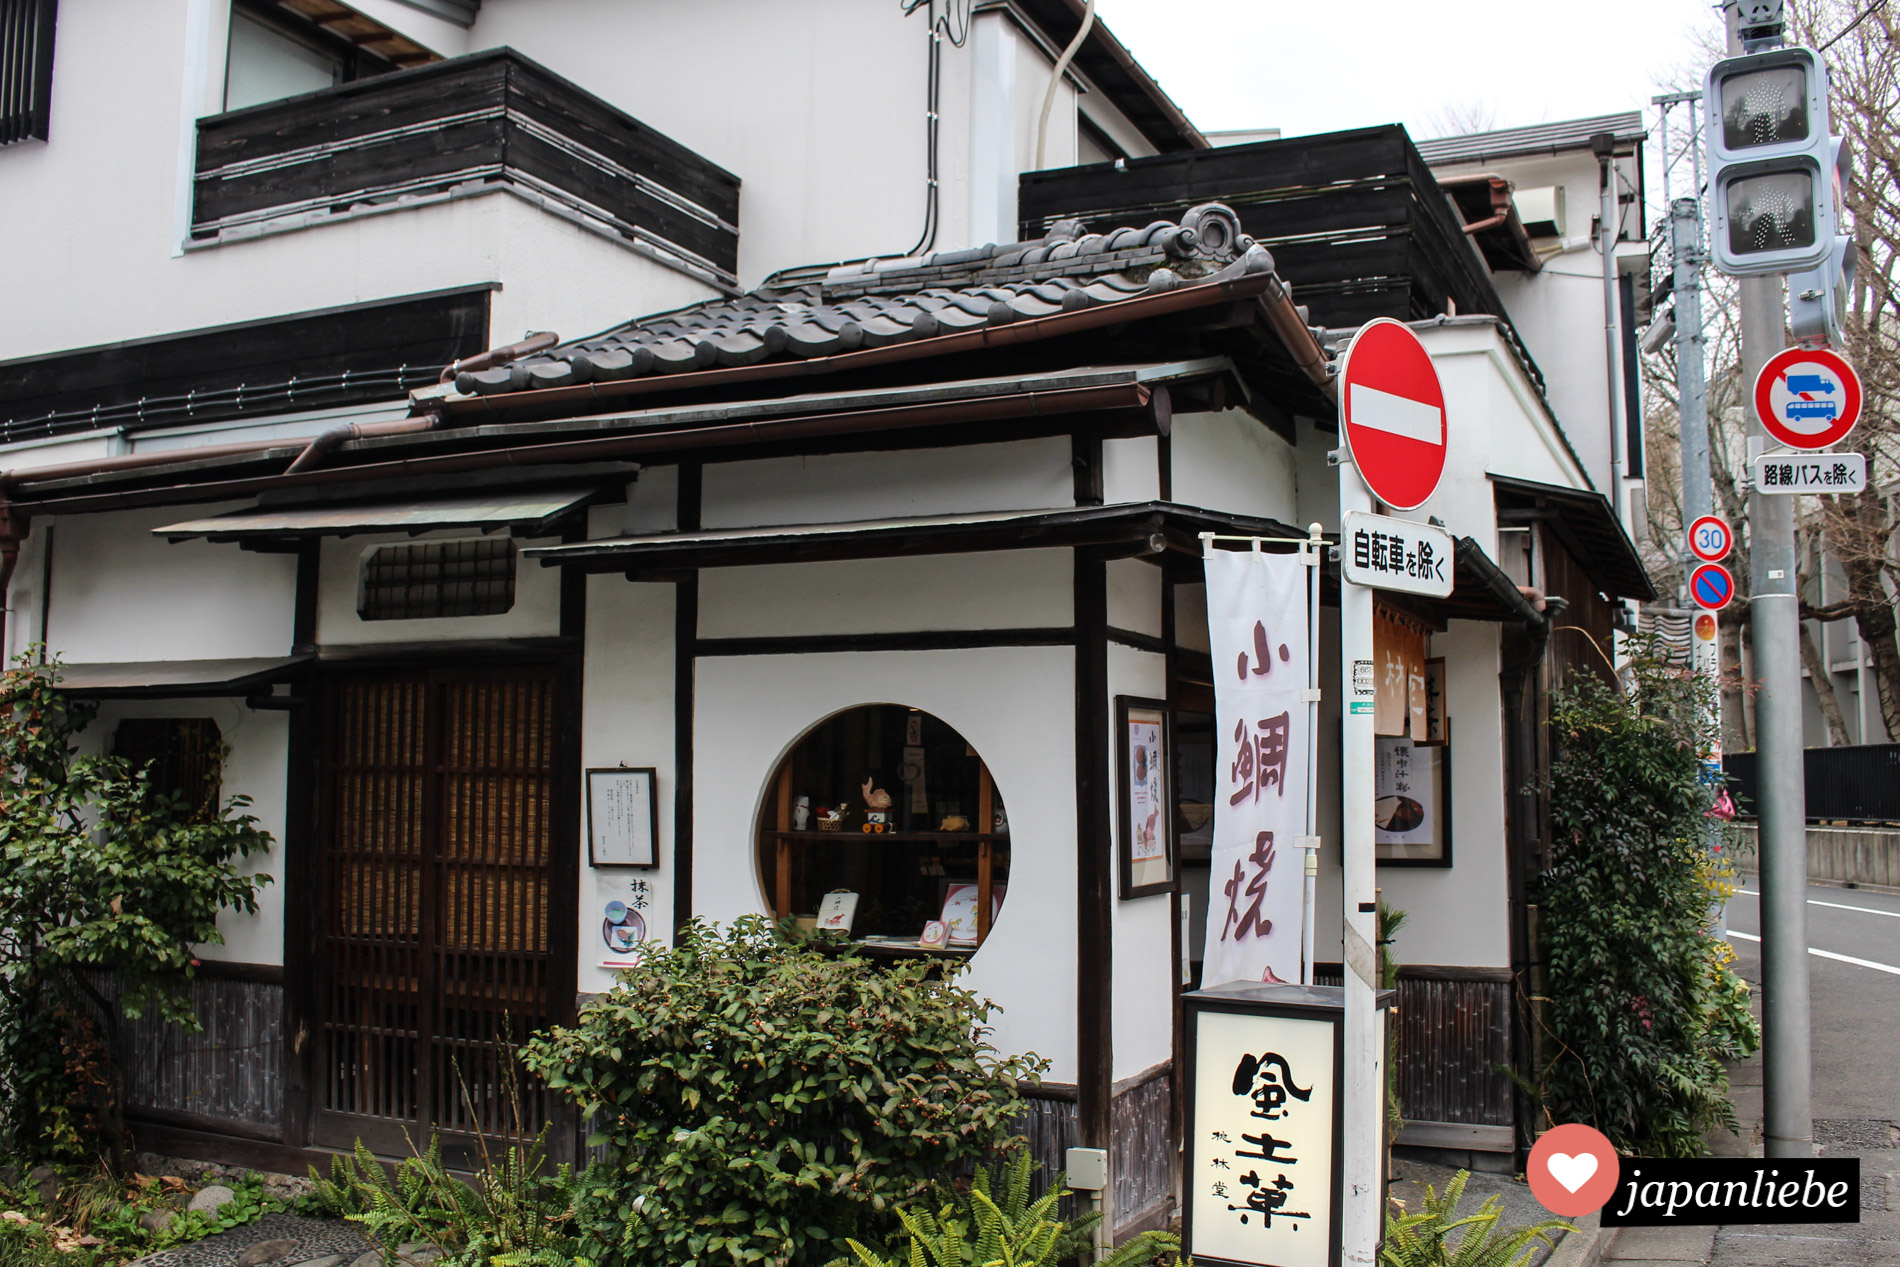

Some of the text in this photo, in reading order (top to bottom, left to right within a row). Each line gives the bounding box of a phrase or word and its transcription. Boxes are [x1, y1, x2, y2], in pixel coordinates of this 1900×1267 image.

[1763, 463, 1856, 487] 路線バスを除く
[1354, 528, 1445, 583] 自転車を除く
[1698, 529, 1722, 549] 30
[630, 878, 649, 910] 抹茶
[1228, 1051, 1314, 1232] 風土菓
[1210, 1130, 1232, 1199] 桃林堂
